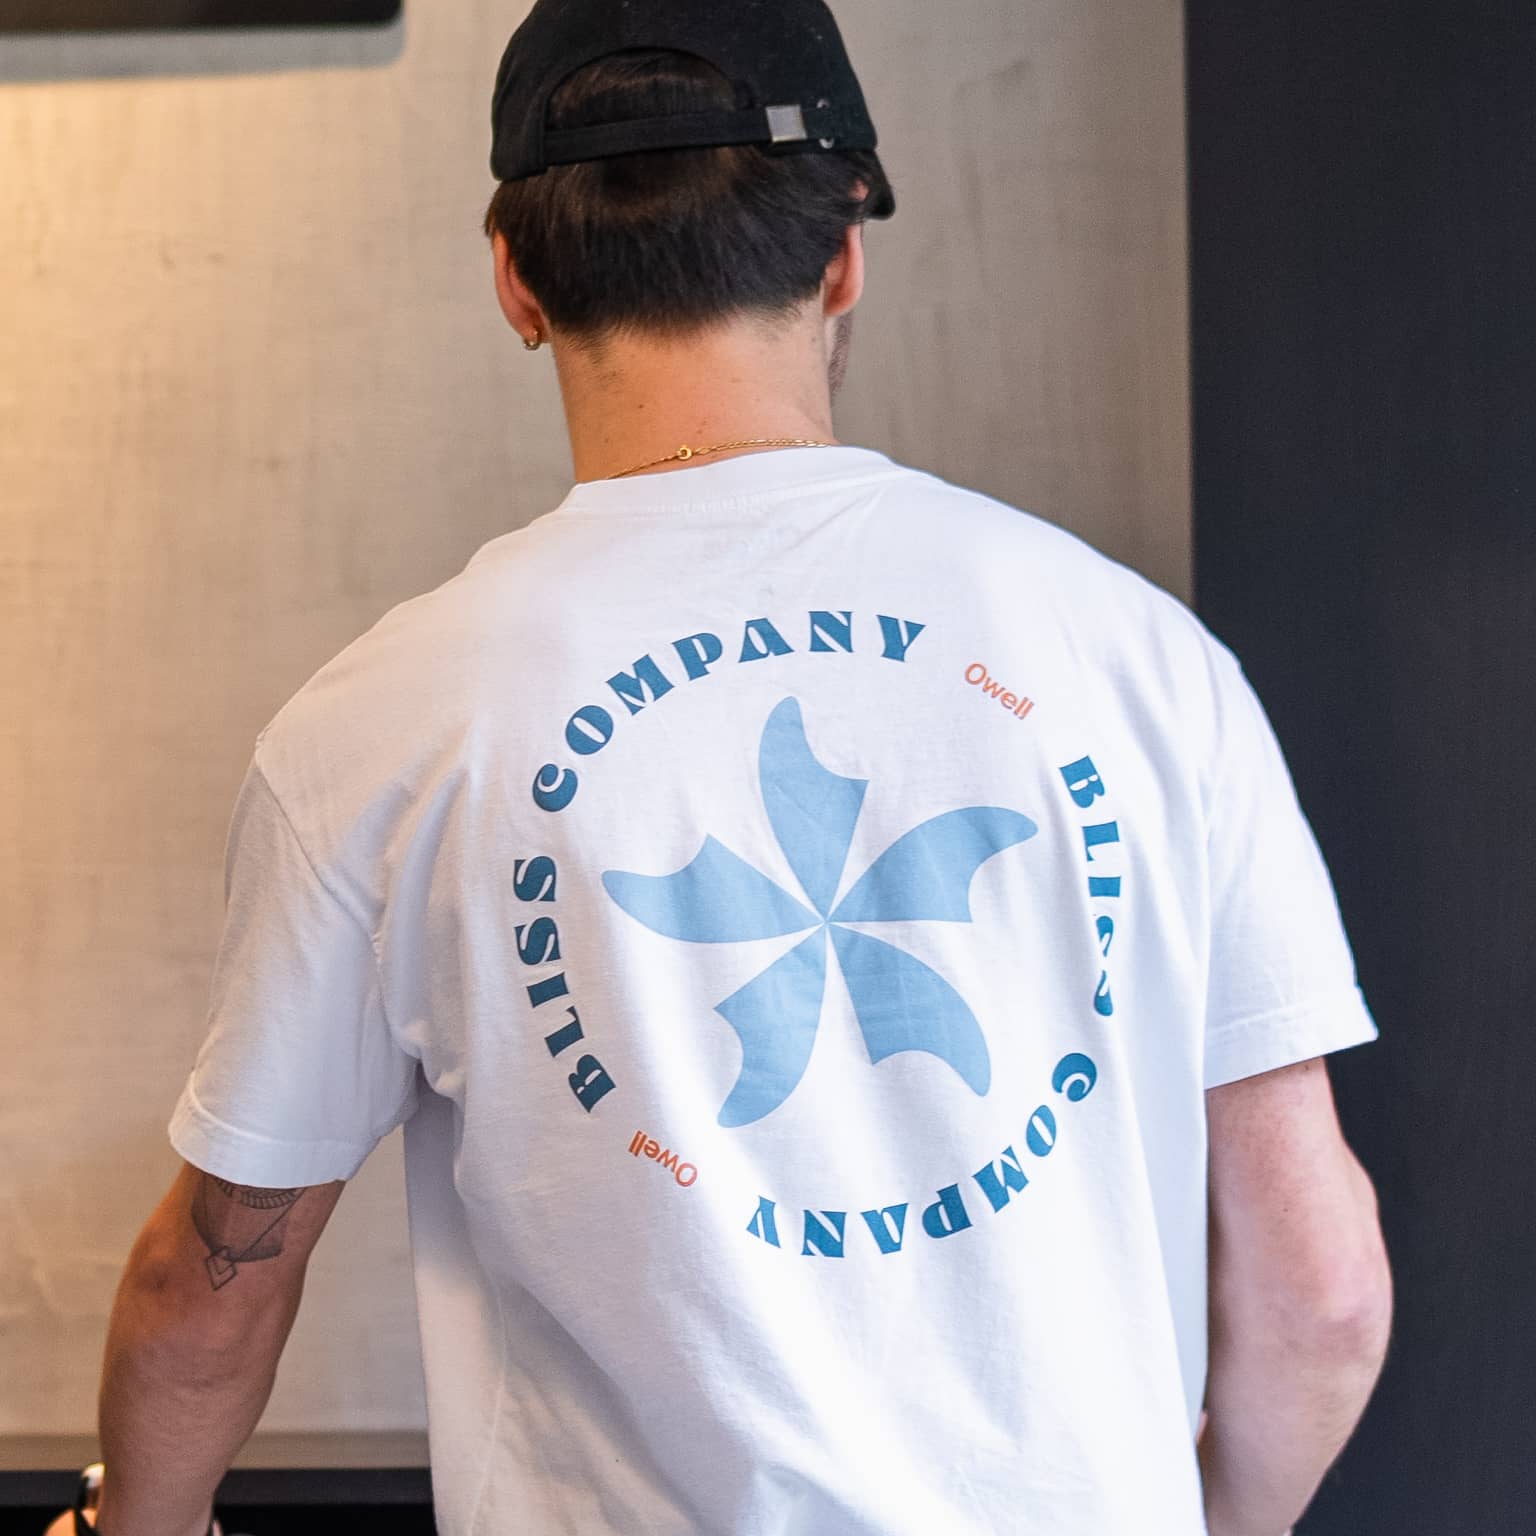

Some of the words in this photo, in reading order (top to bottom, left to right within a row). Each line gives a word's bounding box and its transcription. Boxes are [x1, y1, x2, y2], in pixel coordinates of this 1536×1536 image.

[533, 611, 925, 812] COMPANY
[964, 662, 1034, 720] Owell
[514, 856, 616, 1112] BLISS
[628, 1130, 698, 1187] Owell
[747, 1052, 1098, 1258] COMPANY
